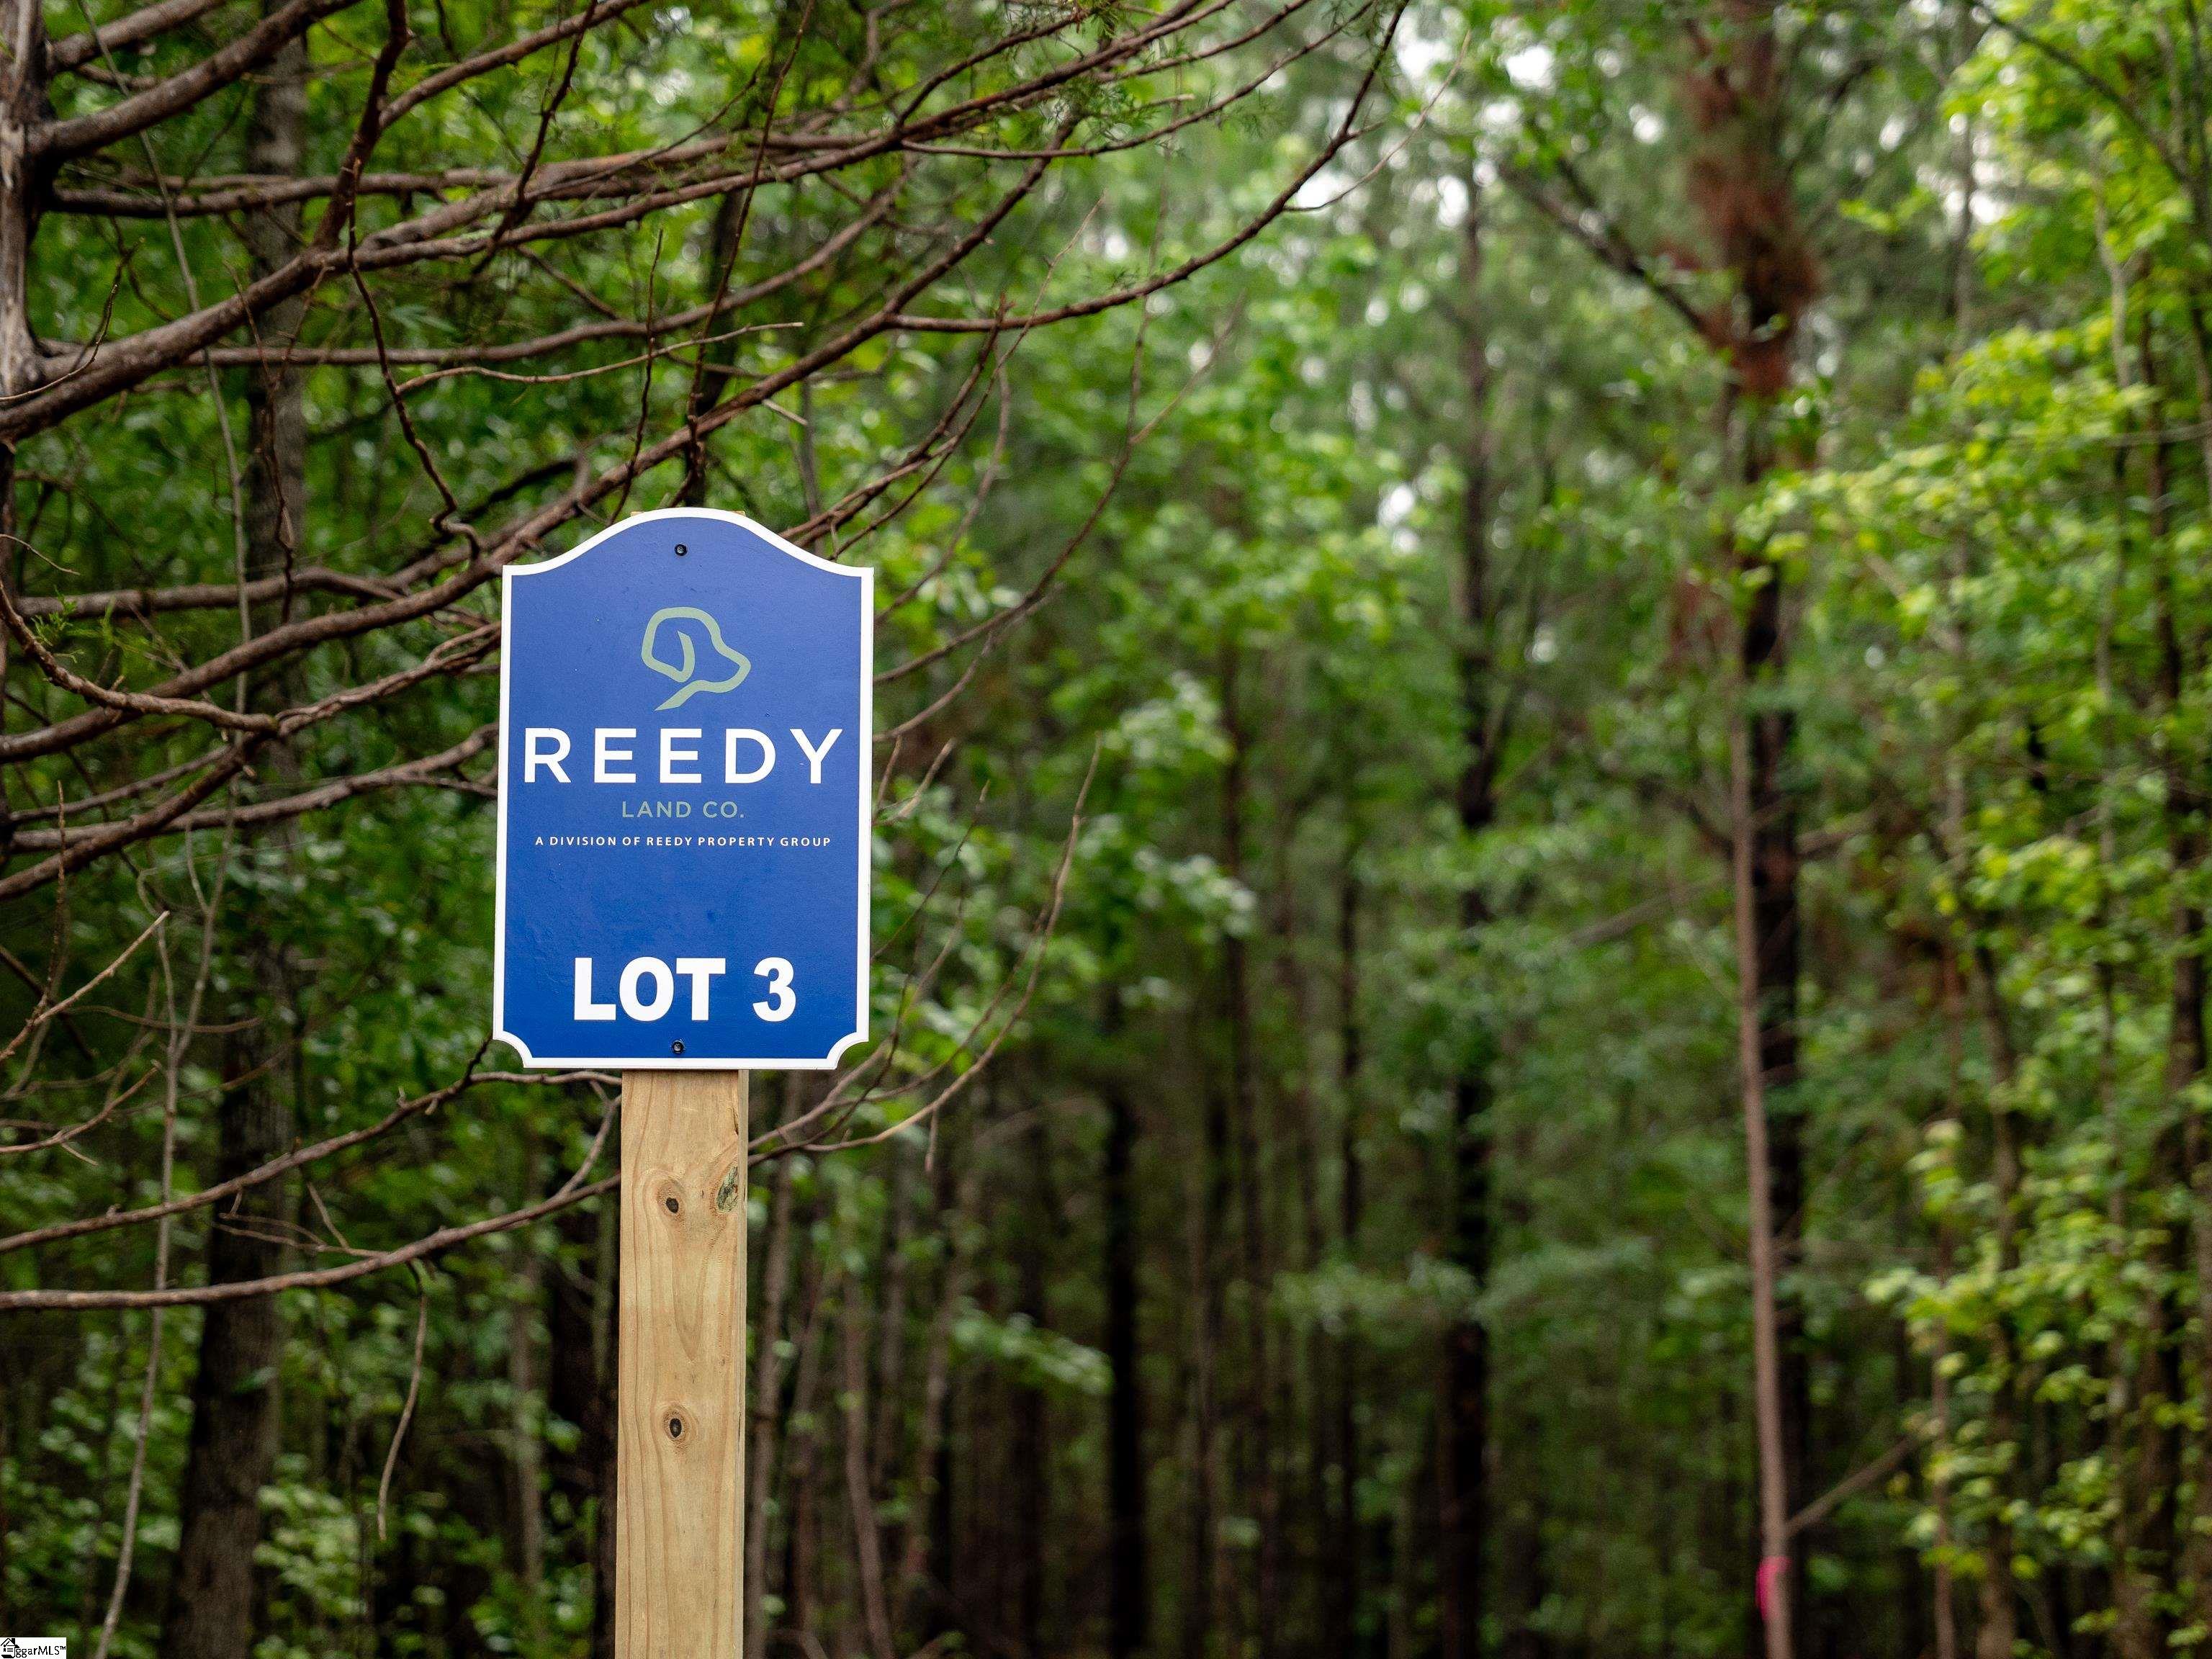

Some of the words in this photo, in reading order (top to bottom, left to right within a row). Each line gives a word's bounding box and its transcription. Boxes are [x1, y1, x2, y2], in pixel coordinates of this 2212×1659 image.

[524, 727, 843, 784] REEDY
[622, 801, 692, 818] LAND
[702, 801, 745, 819] CO.
[535, 836, 544, 846] A
[549, 836, 616, 846] DIVISION
[621, 836, 641, 846] OF
[646, 836, 693, 847] REEDY
[698, 837, 775, 847] PROPERTY
[780, 837, 831, 847] GROUP
[574, 956, 726, 1022] LOT
[752, 957, 796, 1022] 3
